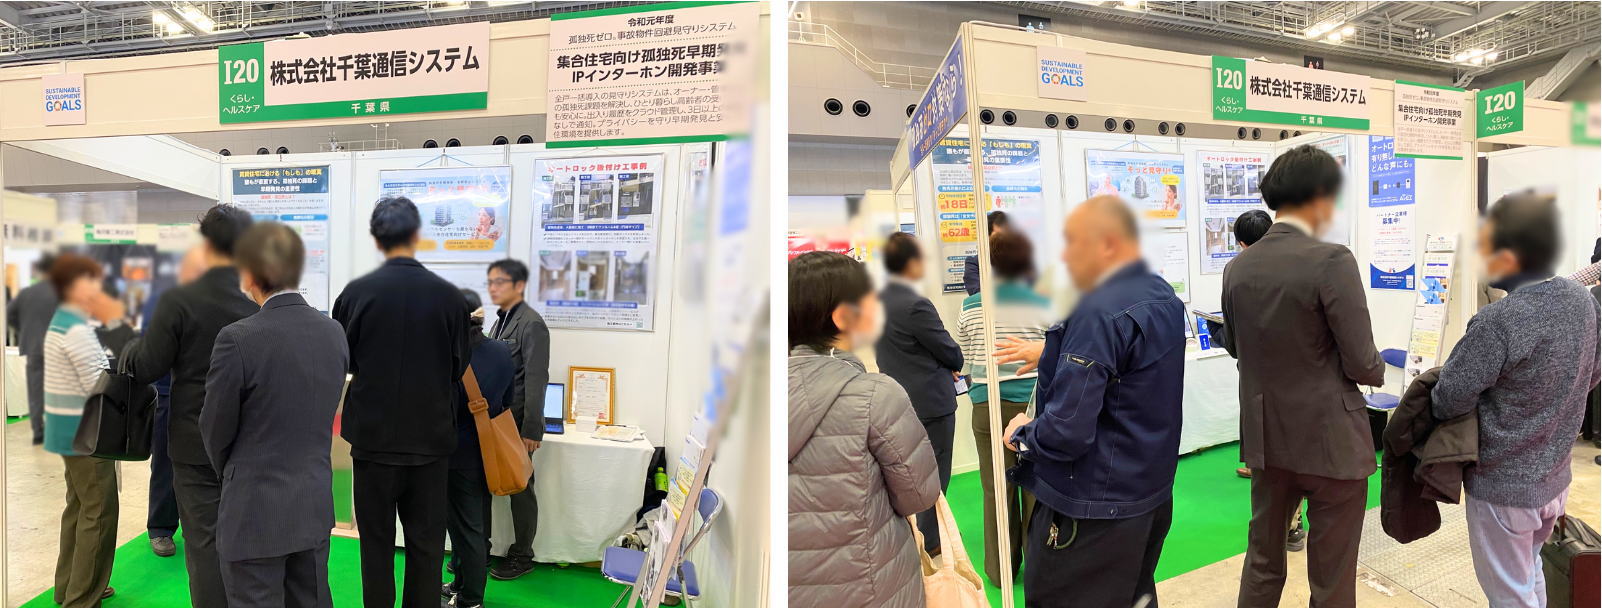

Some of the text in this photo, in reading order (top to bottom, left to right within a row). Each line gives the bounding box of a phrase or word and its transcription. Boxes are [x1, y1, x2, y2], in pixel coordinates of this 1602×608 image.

[627, 15, 675, 28] 令和元年度
[568, 21, 737, 44] 孤独死ゼロ。事故物件回避見守りシステム
[556, 42, 745, 70] 集合住宅向け孤独死早期
[270, 45, 481, 87] 株式会社千葉通信システム
[1040, 58, 1082, 70] SUSTAINABLE
[1040, 66, 1082, 76] DEVELOPMENT
[224, 58, 260, 86] I20
[1216, 68, 1243, 90] I20
[1042, 72, 1084, 88] GOALS
[1249, 76, 1366, 105] 株式会社千葉通信システム
[46, 100, 82, 112] GOALS
[222, 104, 260, 114] ヘルスケア
[350, 101, 390, 114] 千葉県
[1216, 105, 1244, 114] ヘルスケア
[1484, 90, 1516, 115] I20
[555, 106, 721, 120] も安心に。出入り履歴をクラウド管理し、3日以上
[1486, 122, 1514, 132] ヘルスケア
